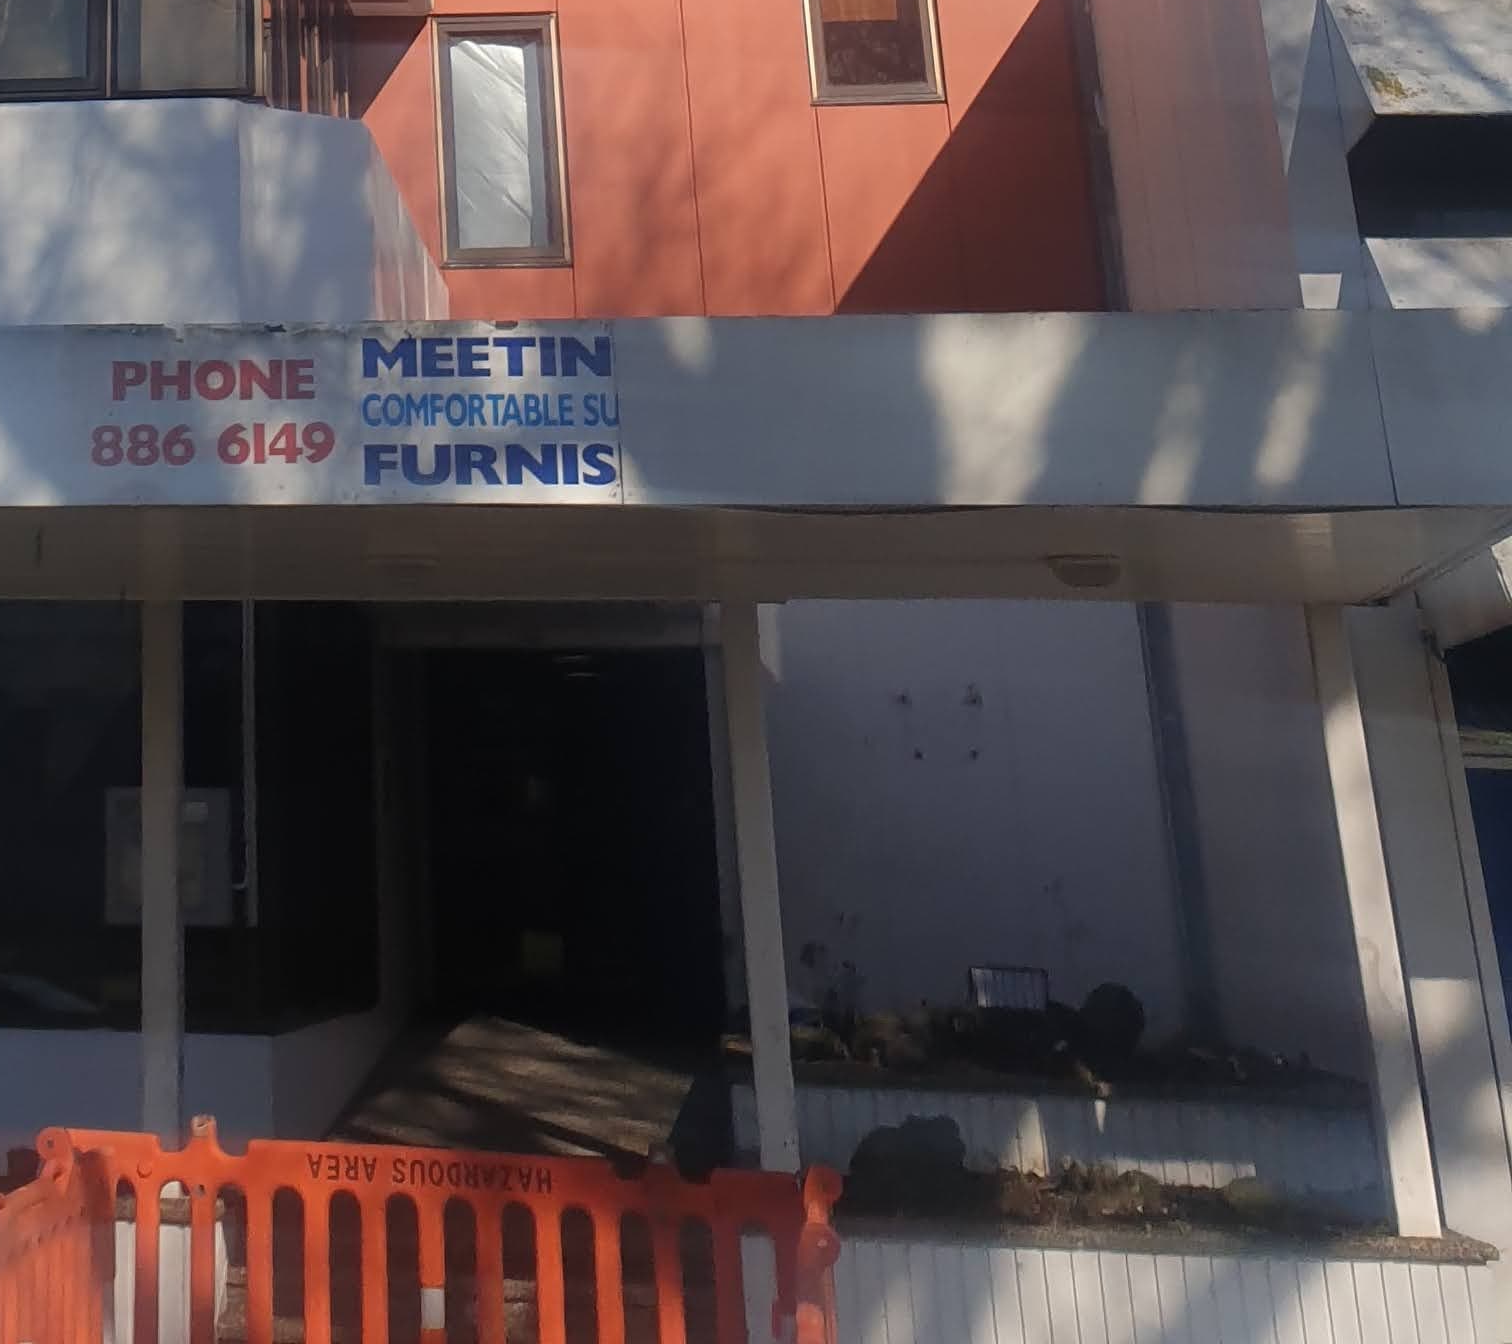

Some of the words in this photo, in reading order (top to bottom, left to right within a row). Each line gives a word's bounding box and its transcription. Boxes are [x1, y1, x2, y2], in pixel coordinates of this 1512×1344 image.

[362, 337, 612, 378] MEETIN
[112, 358, 316, 401] PHONE
[362, 393, 575, 427] COMFORTABLE
[582, 393, 619, 427] SU
[91, 424, 196, 466] 886
[217, 421, 336, 465] 6149
[364, 442, 617, 486] FURNIS
[307, 1153, 376, 1181] AREA
[392, 1157, 552, 1193] HAZARDOUS
